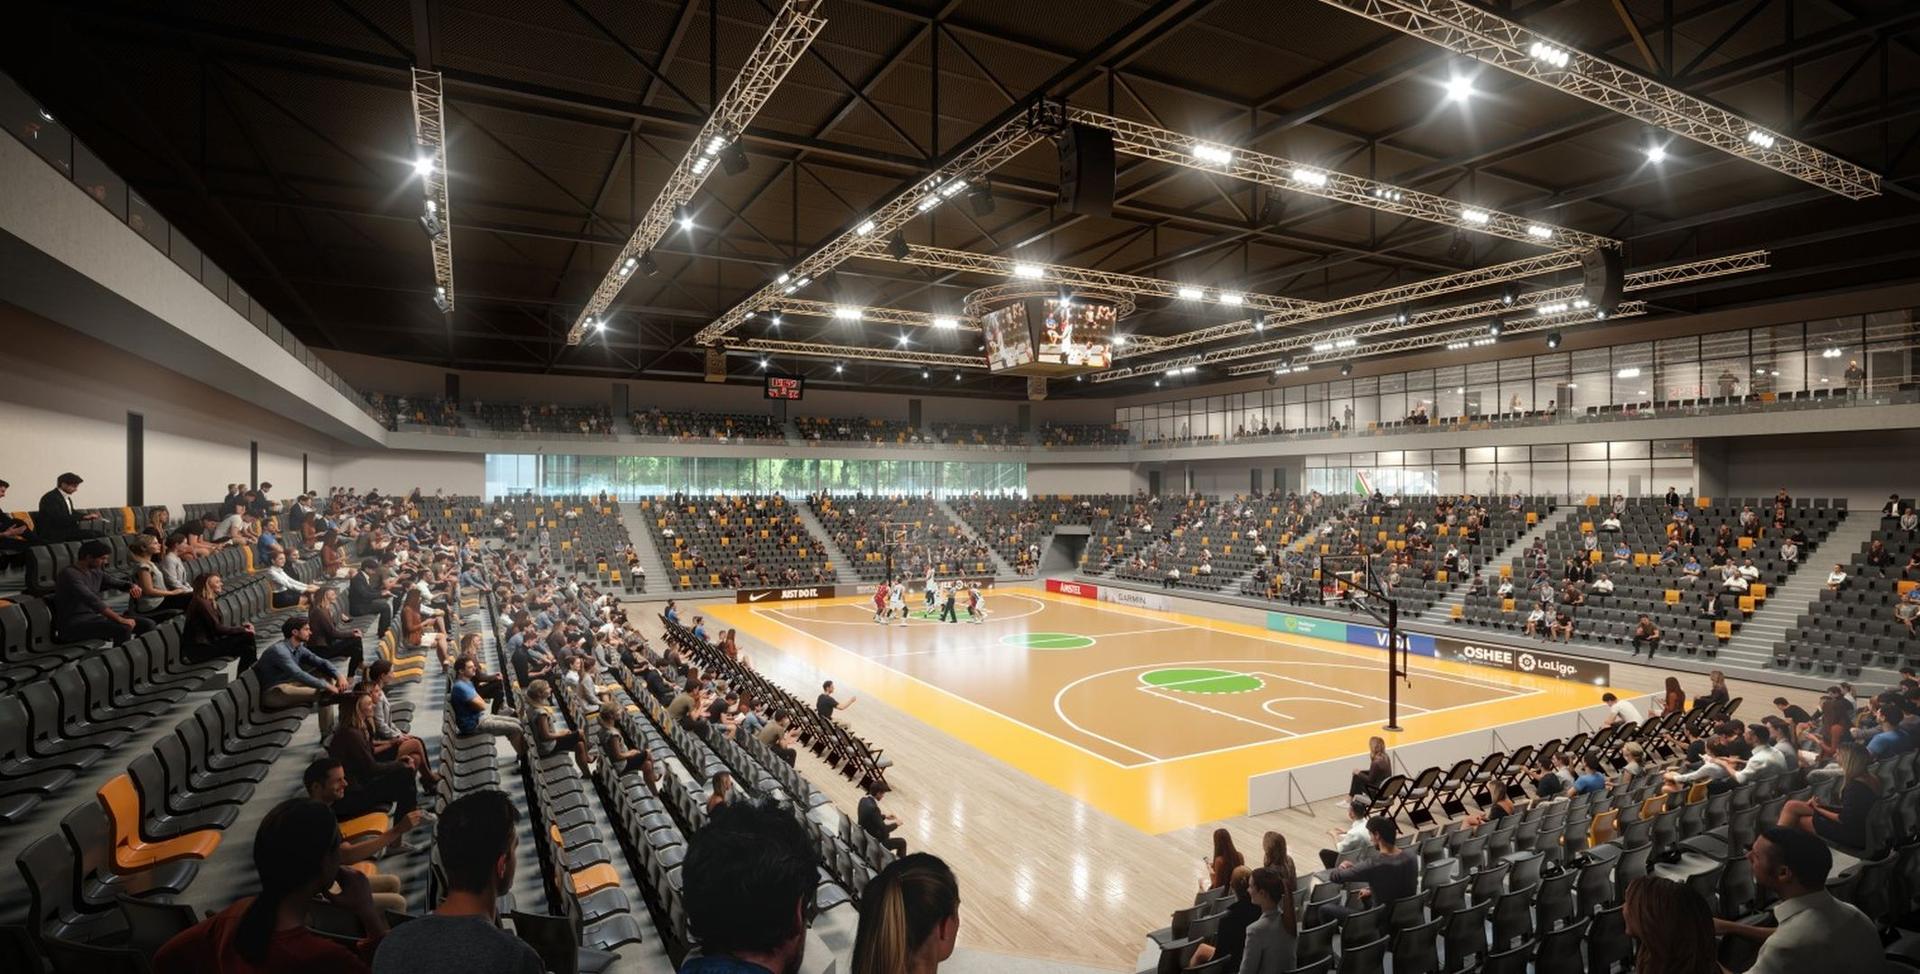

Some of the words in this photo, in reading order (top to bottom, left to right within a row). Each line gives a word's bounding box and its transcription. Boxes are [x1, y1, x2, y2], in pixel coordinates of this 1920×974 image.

[781, 589, 798, 599] JUST
[798, 589, 810, 598] DO
[1464, 646, 1513, 664] OSHEE
